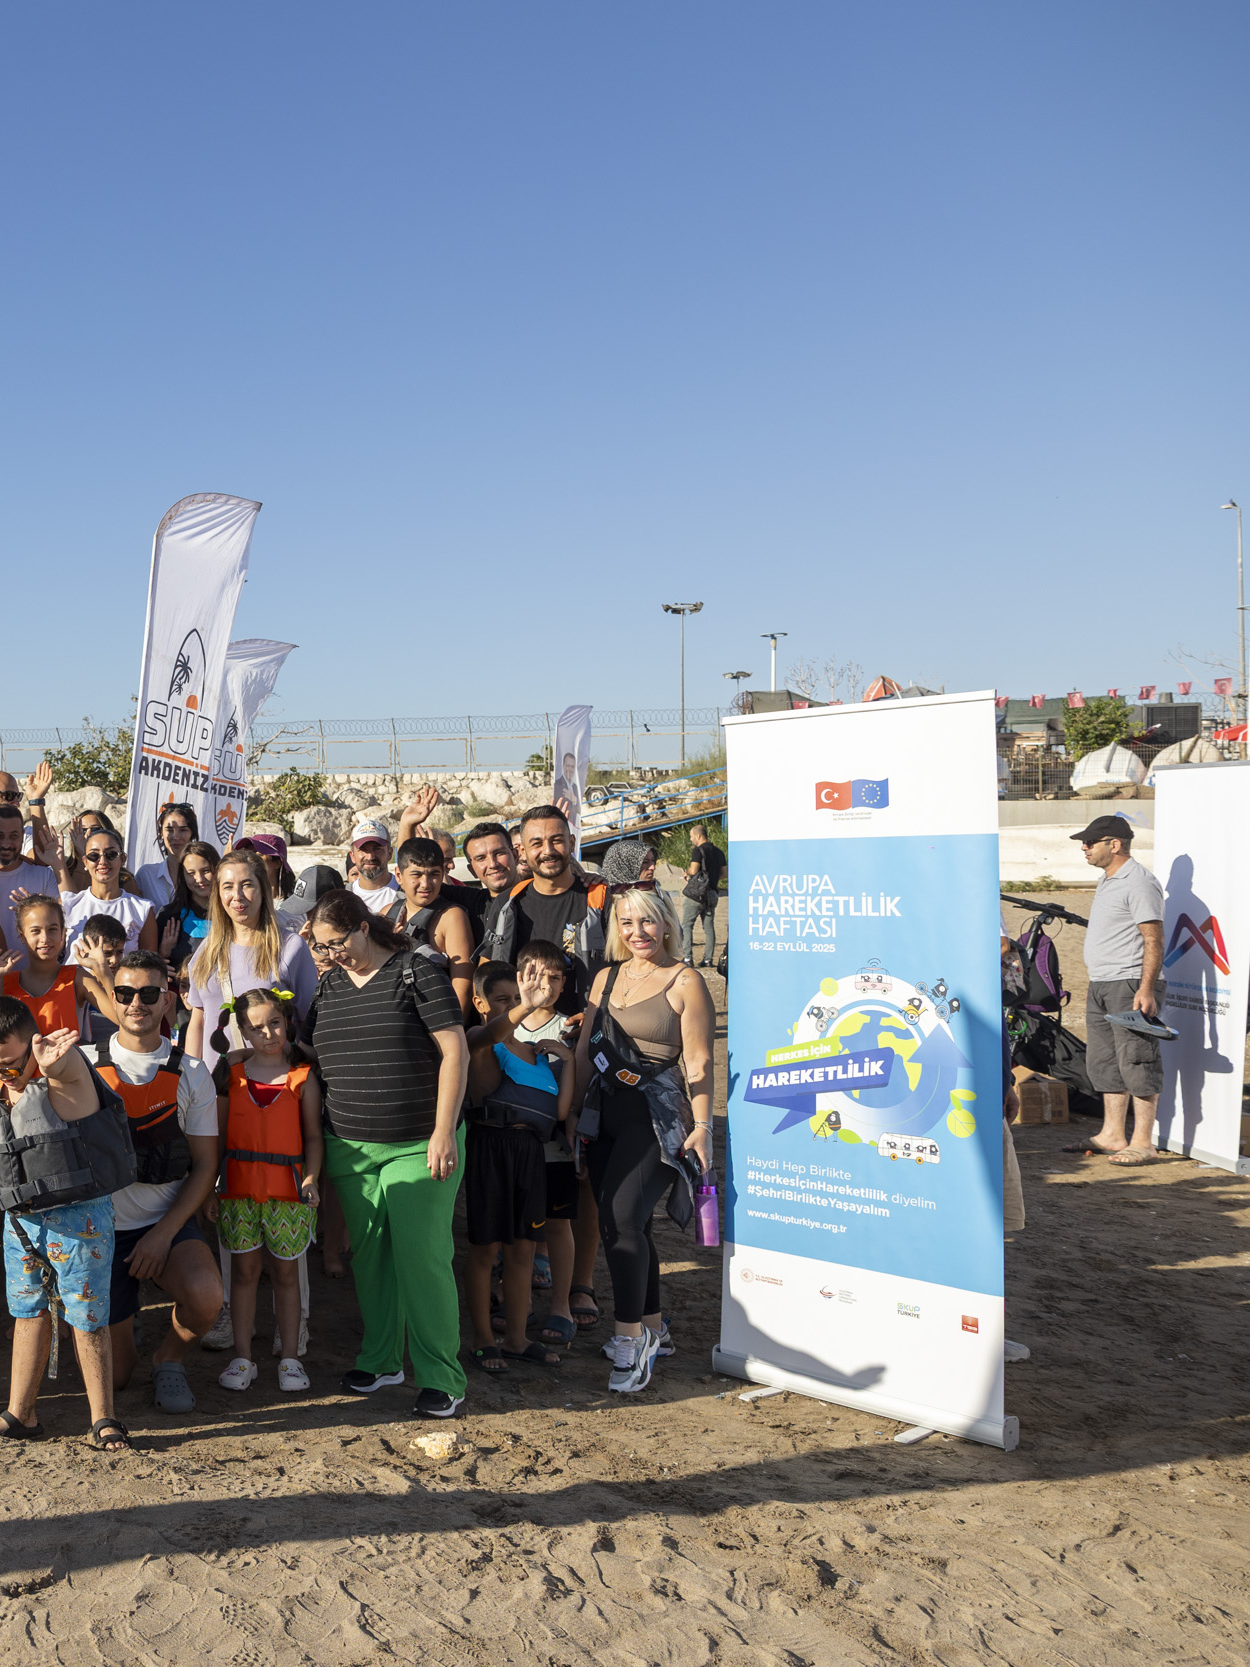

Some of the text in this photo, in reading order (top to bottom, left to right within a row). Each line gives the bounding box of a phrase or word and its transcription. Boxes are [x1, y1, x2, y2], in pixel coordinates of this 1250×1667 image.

[142, 700, 214, 760] SUP
[749, 874, 836, 894] AVRUPA
[748, 892, 902, 917] HAREKETLİLİK
[748, 917, 836, 938] HAFTASI
[748, 940, 836, 952] 16-22 EYLÜL 2025
[770, 1044, 831, 1063] HERKES İÇİN
[752, 1056, 885, 1089] HAREKETLİLİK
[149, 1101, 166, 1111] ITIWIT
[747, 1156, 852, 1180] Haydi Hep Birlikte
[747, 1170, 936, 1210] #HerkesİçinHareketlilik diyelim
[747, 1184, 890, 1218] #ŞehriBirlikteYaşayalım
[747, 1209, 847, 1233] www.skupturkiye.org.tr
[897, 1302, 920, 1312] SKUP
[897, 1310, 920, 1320] TÜRKİYE
